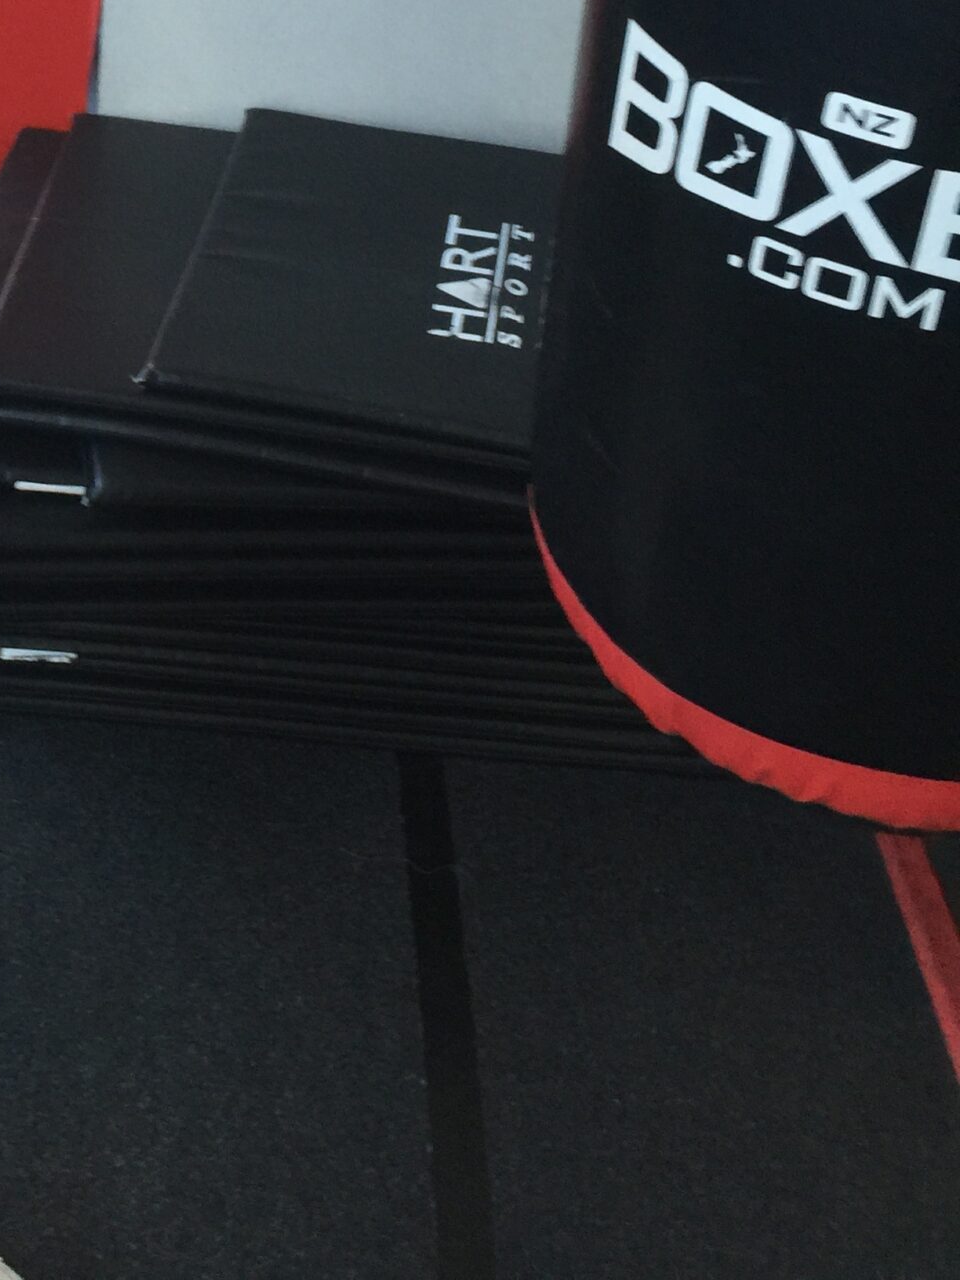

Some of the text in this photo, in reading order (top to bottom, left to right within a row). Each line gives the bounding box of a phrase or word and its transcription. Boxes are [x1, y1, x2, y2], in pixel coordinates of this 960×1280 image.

[840, 101, 901, 138] NZ
[426, 213, 499, 343] HART
[496, 223, 536, 349] SPORT
[726, 235, 947, 331] .COM
